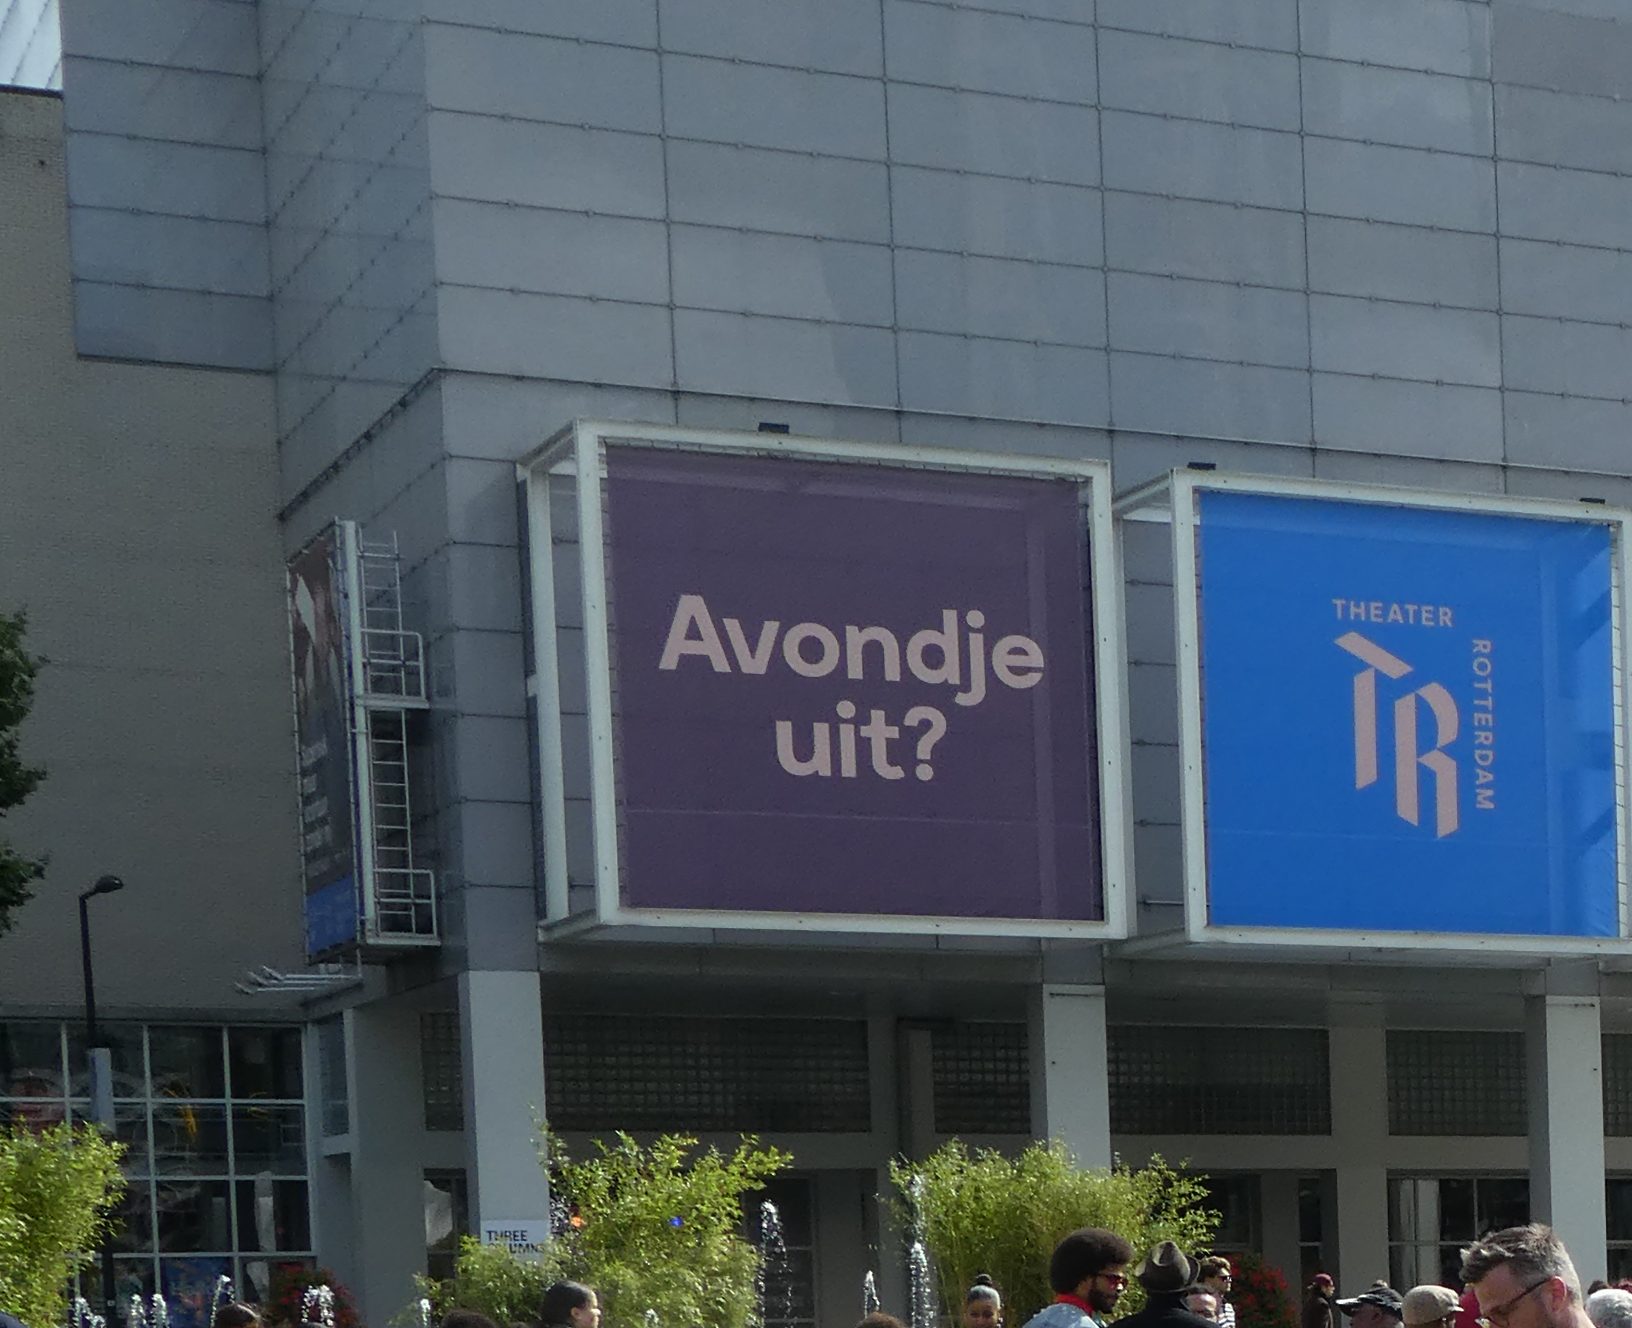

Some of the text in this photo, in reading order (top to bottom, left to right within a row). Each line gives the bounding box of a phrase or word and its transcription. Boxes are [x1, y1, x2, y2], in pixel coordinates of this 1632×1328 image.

[658, 594, 1045, 707] Avondje
[1332, 598, 1454, 628] THEATER
[775, 700, 948, 781] uit?
[1471, 638, 1495, 810] ROTTERDAM
